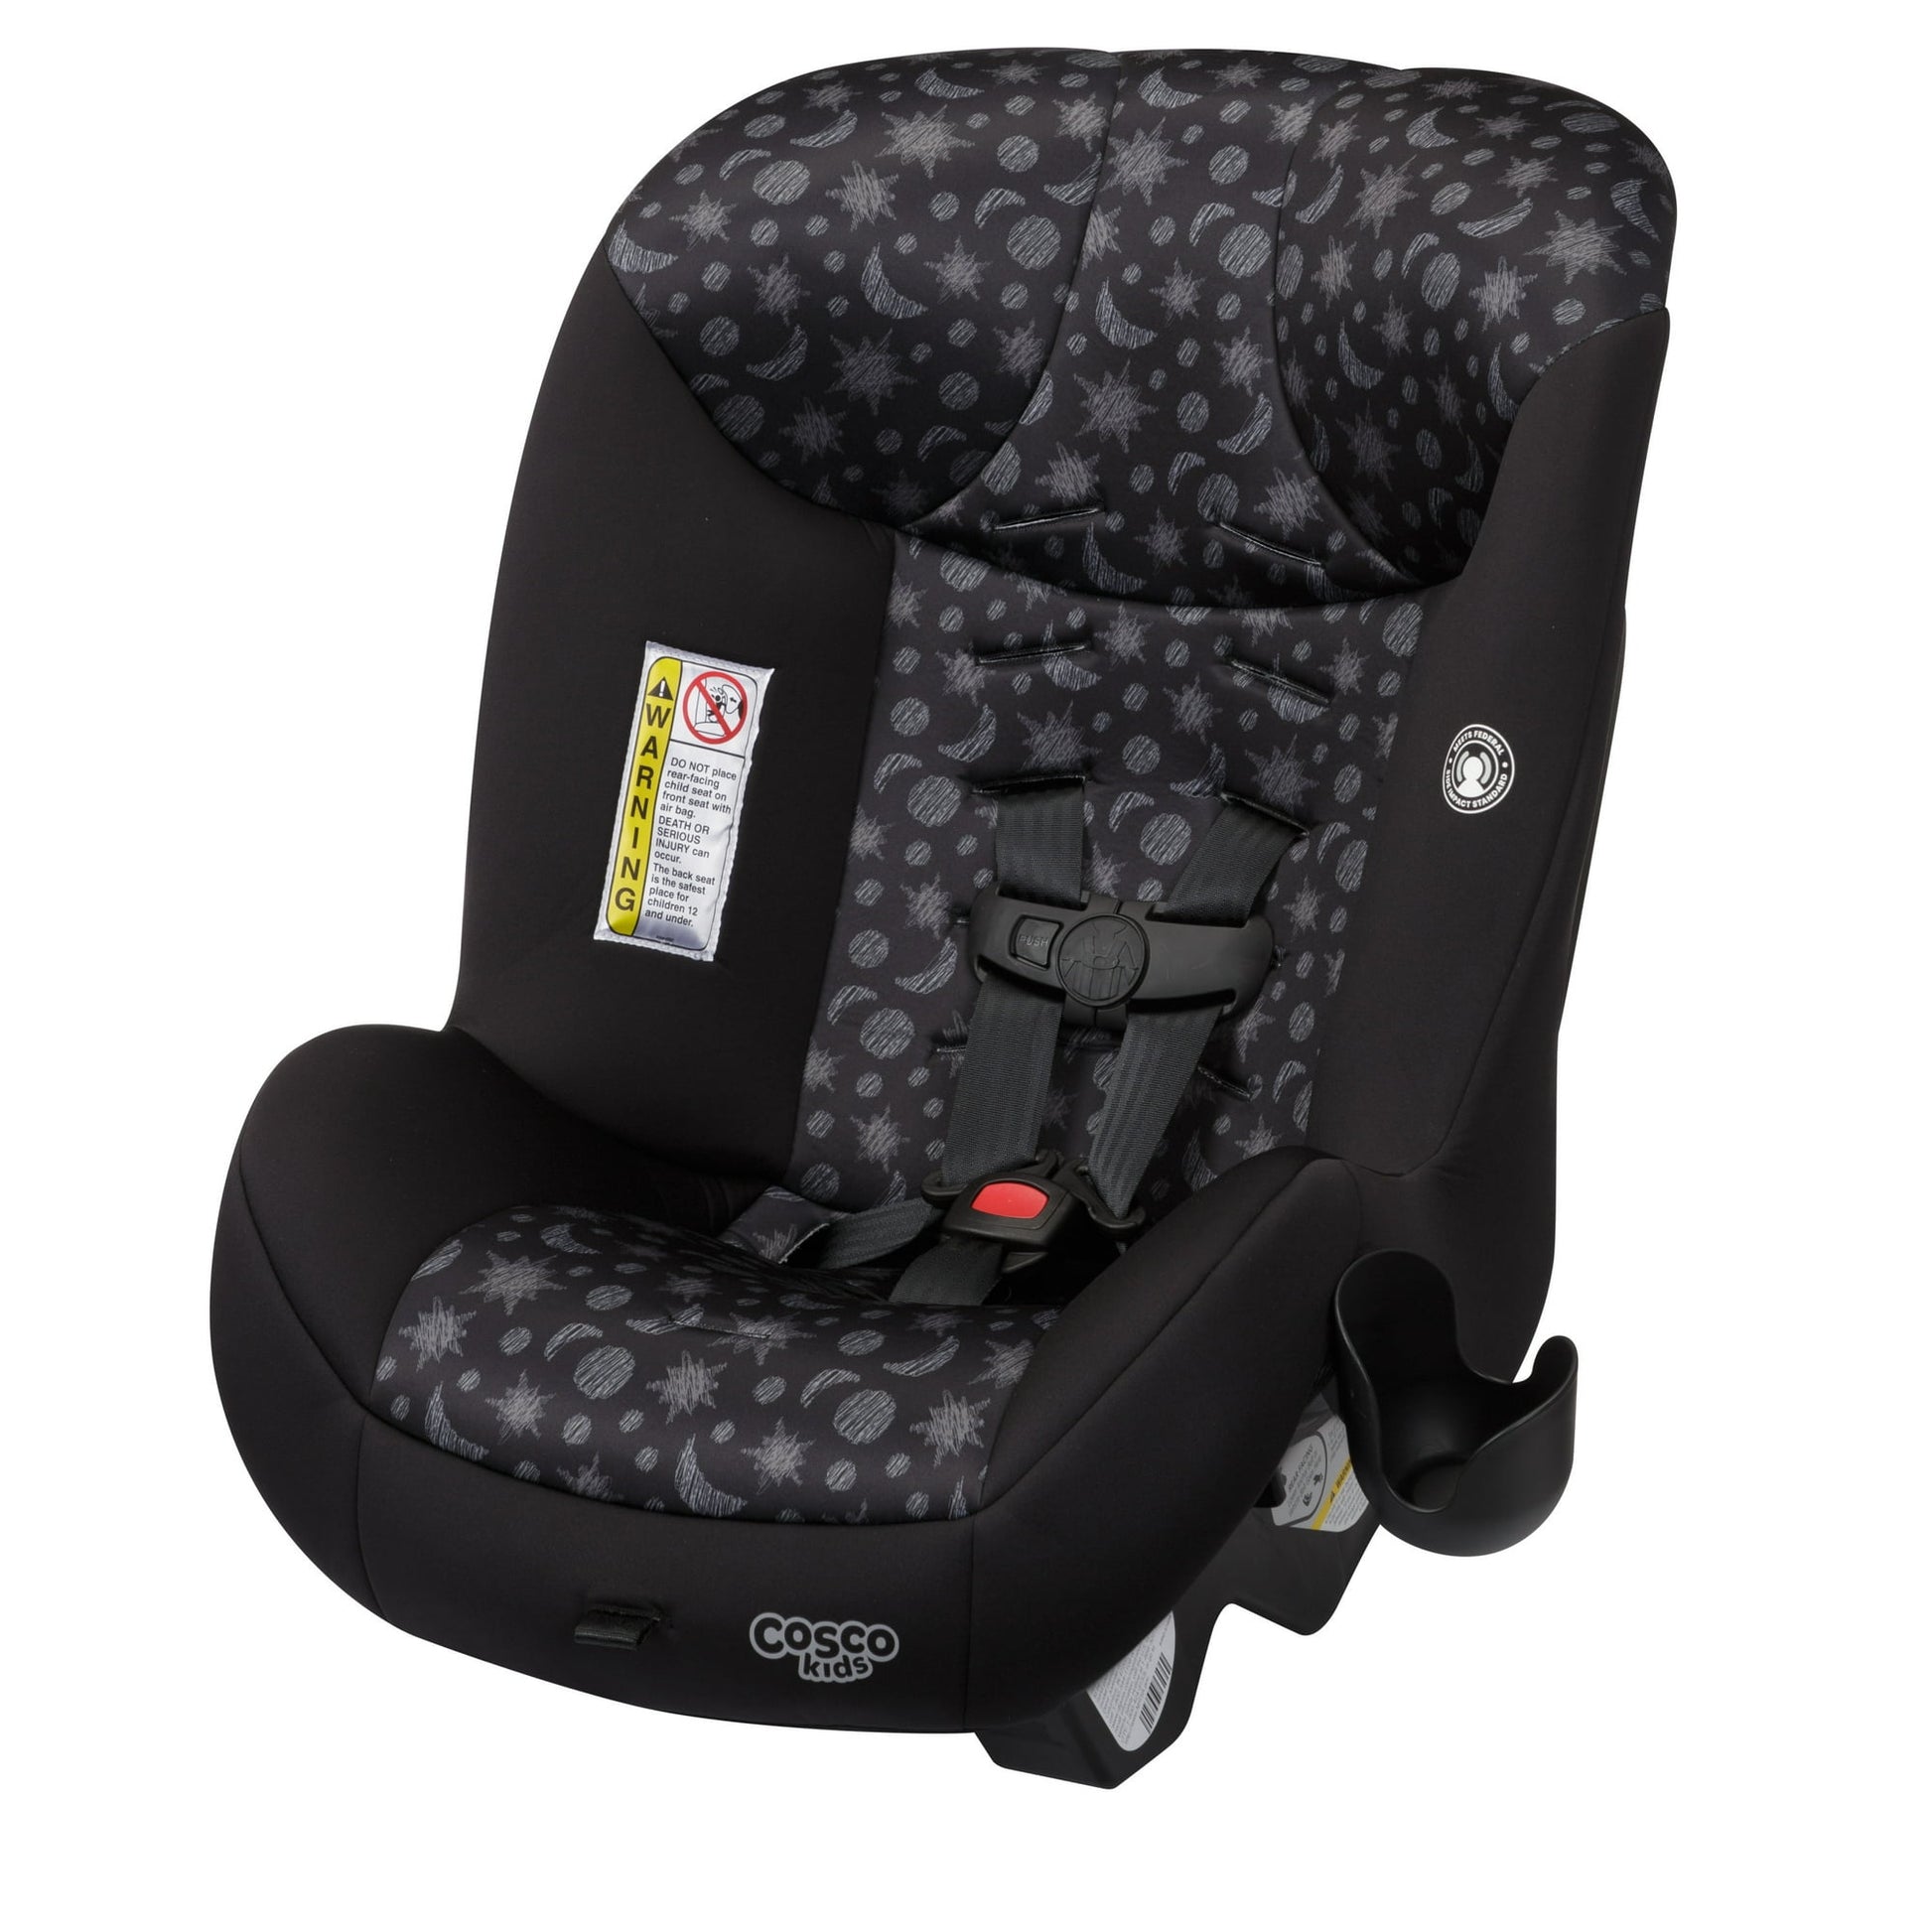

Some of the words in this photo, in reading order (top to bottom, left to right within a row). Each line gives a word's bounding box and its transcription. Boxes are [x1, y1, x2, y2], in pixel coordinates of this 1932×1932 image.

[1452, 731, 1472, 753] MEETS
[1474, 730, 1505, 757] FEDERAL
[667, 769, 720, 789] rear-facing
[671, 758, 686, 768] DO
[689, 761, 710, 773] NOT
[712, 767, 737, 780] place
[664, 780, 689, 792] child
[691, 786, 713, 797] seat
[715, 792, 727, 801] on
[1448, 788, 1471, 808] IMPACT
[1471, 773, 1508, 808] STANDARD
[615, 703, 671, 911] WARNING
[660, 802, 673, 812] air
[675, 803, 696, 819] bag.
[662, 790, 686, 803] front
[688, 796, 710, 809] seat
[712, 803, 732, 814] with
[658, 815, 692, 831] DEATH
[695, 823, 710, 835] OR
[657, 827, 701, 844] SERIOUS
[654, 851, 681, 864] occur.
[655, 838, 690, 853] INJURY
[692, 848, 710, 858] can
[653, 863, 669, 875] The
[672, 867, 693, 881] back
[695, 874, 715, 886] seat
[649, 887, 674, 898] place
[677, 893, 689, 901] for
[651, 875, 659, 884] is
[662, 877, 676, 888] the
[678, 882, 706, 895] safest
[647, 897, 685, 912] children
[688, 906, 698, 916] 12
[645, 909, 663, 919] and
[665, 914, 694, 927] under.
[1019, 935, 1048, 947] PUSH
[802, 1652, 870, 1679] kids
